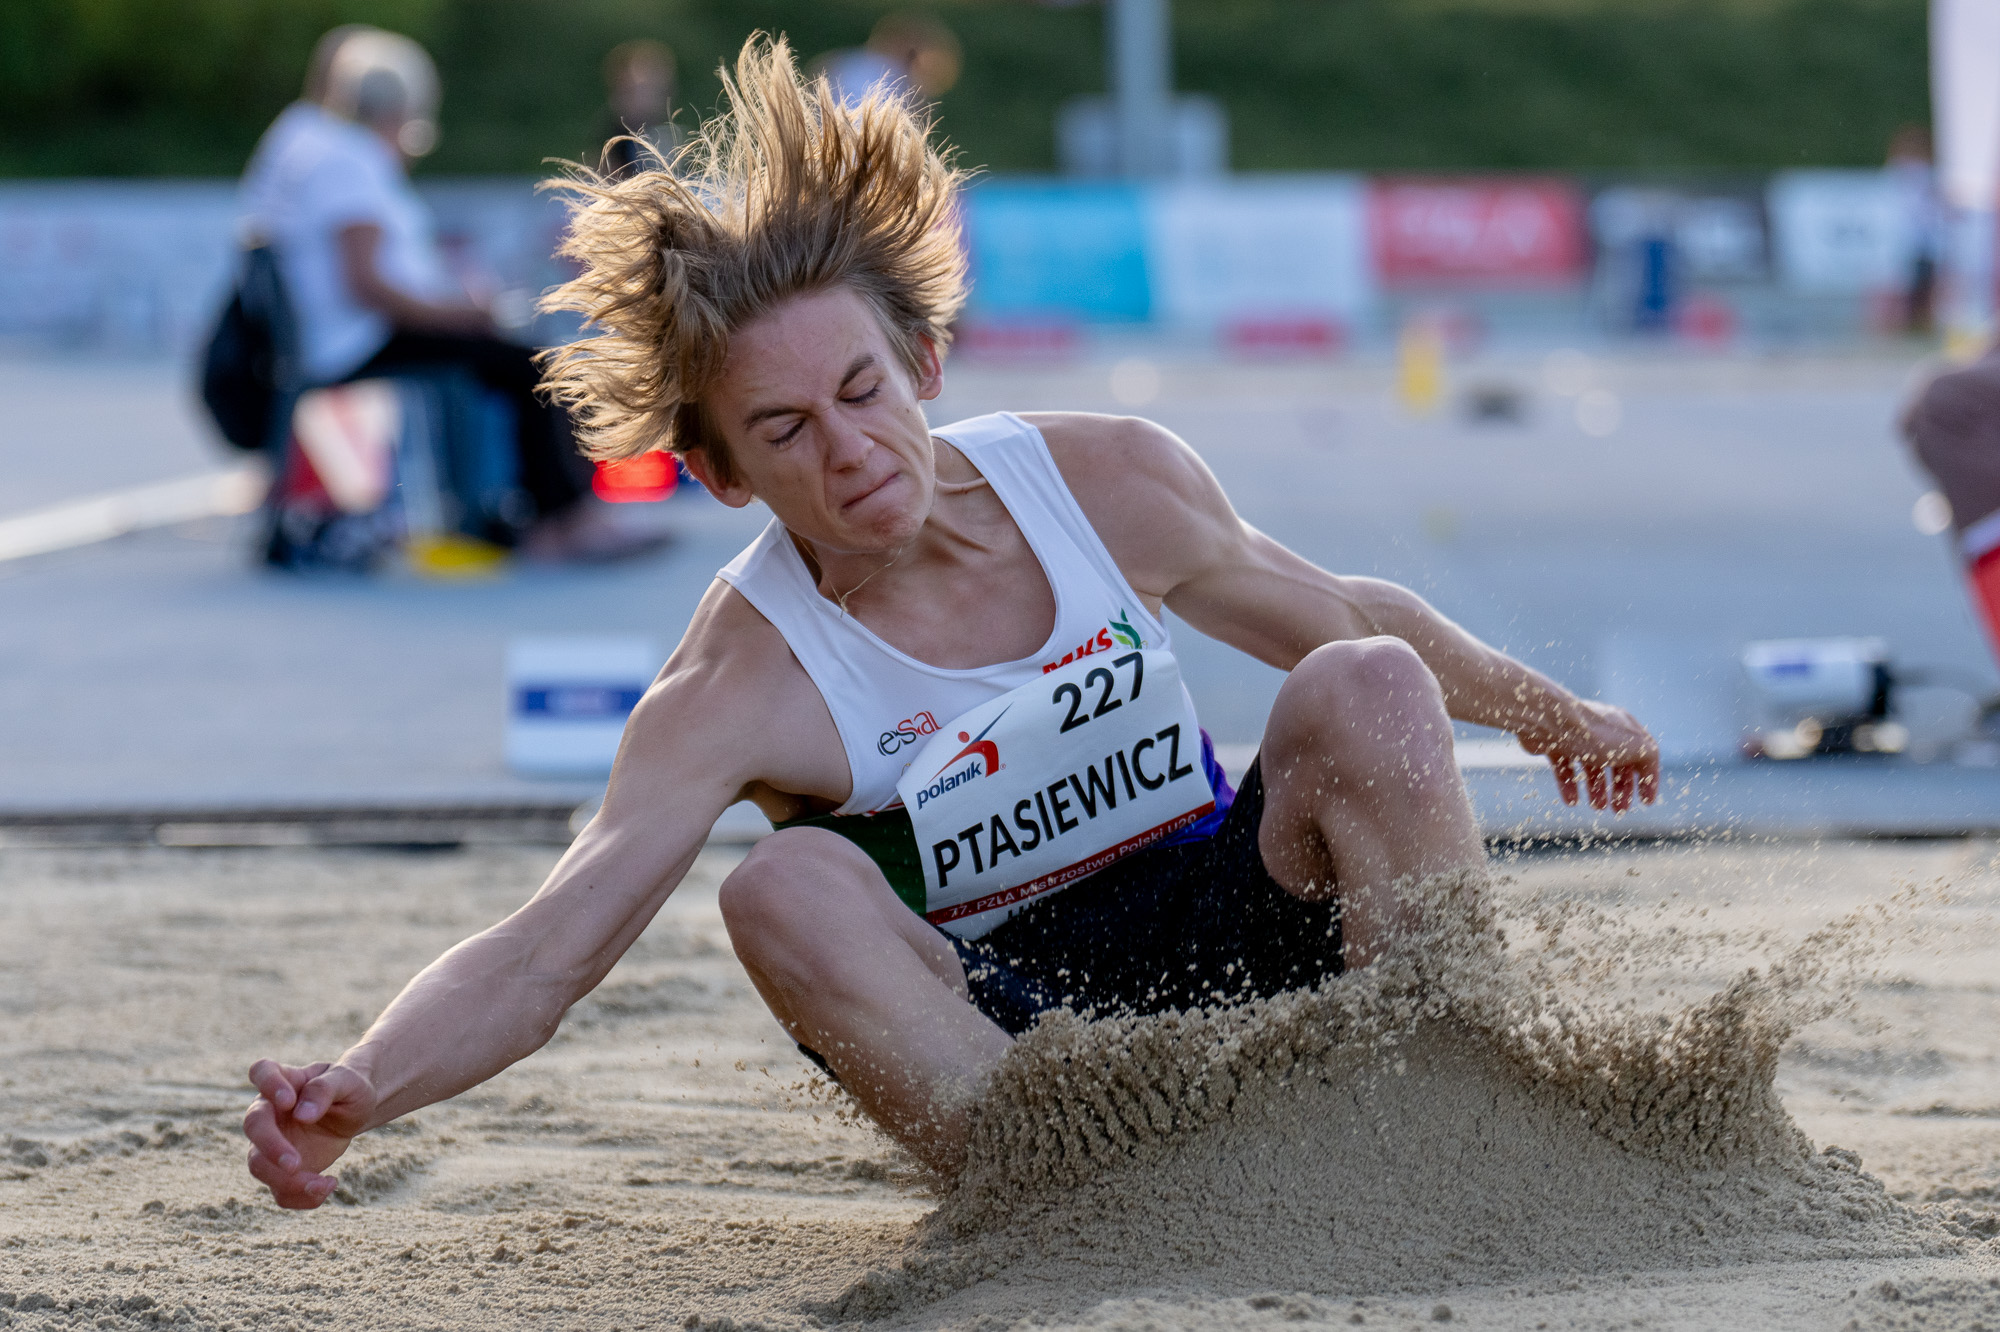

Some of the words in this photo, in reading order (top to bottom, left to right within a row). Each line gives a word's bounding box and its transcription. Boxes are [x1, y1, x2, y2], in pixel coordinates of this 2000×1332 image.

[1052, 651, 1143, 734] 227
[916, 761, 982, 810] polanik
[932, 723, 1193, 888] PTASIEWICZ
[1020, 852, 1115, 897] Mistrzostwa
[1119, 828, 1163, 856] Polski
[1168, 813, 1197, 833] U20
